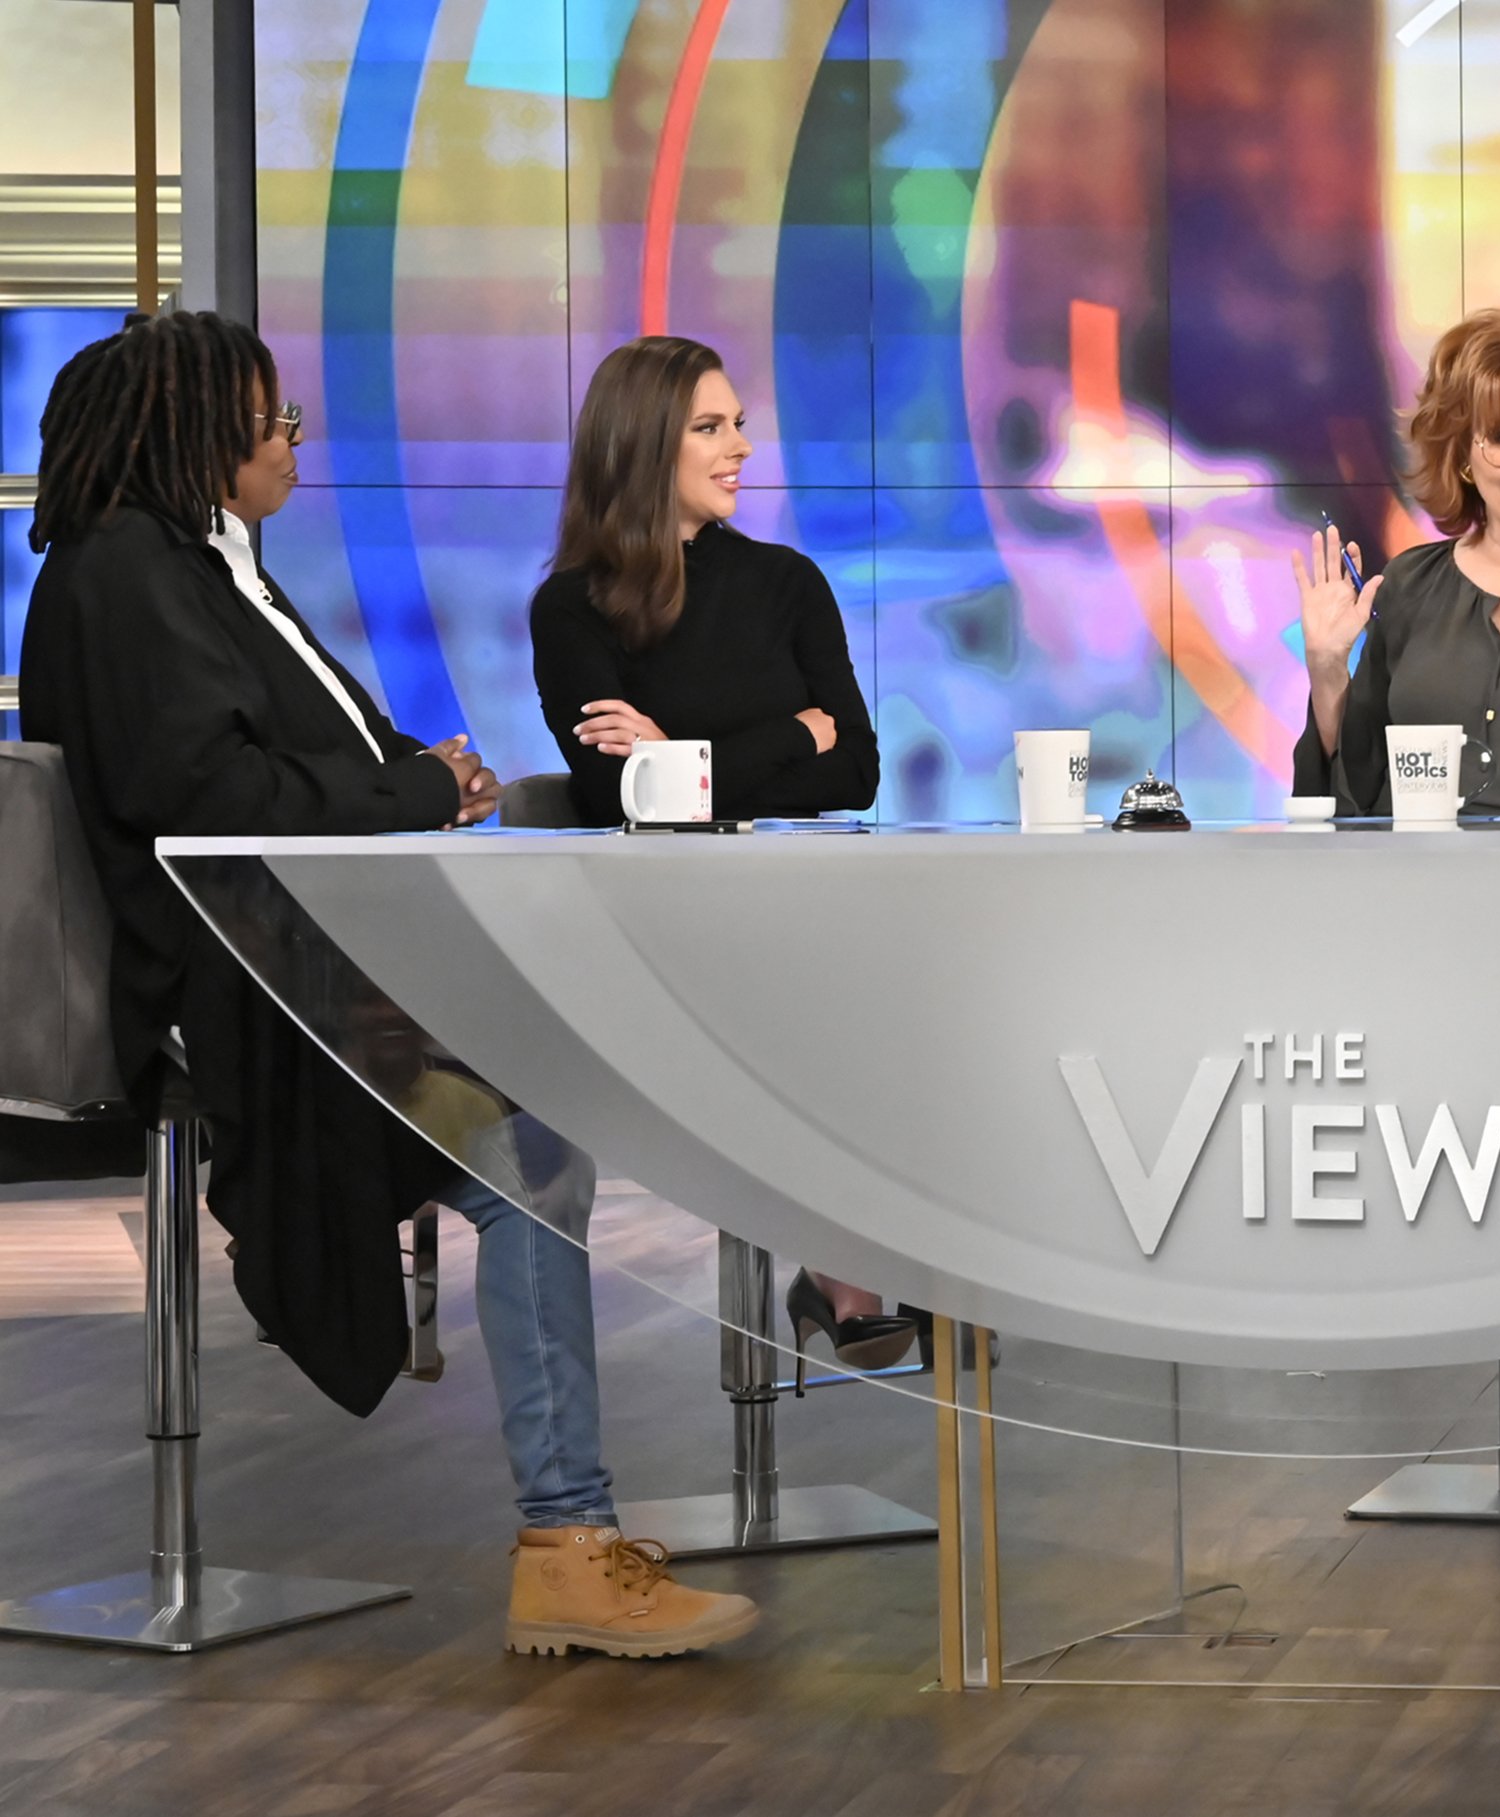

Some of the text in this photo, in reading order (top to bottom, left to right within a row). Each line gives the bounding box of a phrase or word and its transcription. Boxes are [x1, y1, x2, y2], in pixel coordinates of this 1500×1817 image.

[1069, 756, 1088, 771] HO
[1395, 752, 1432, 767] HOT
[1396, 767, 1448, 778] TOPICS
[1243, 1033, 1366, 1080] THE
